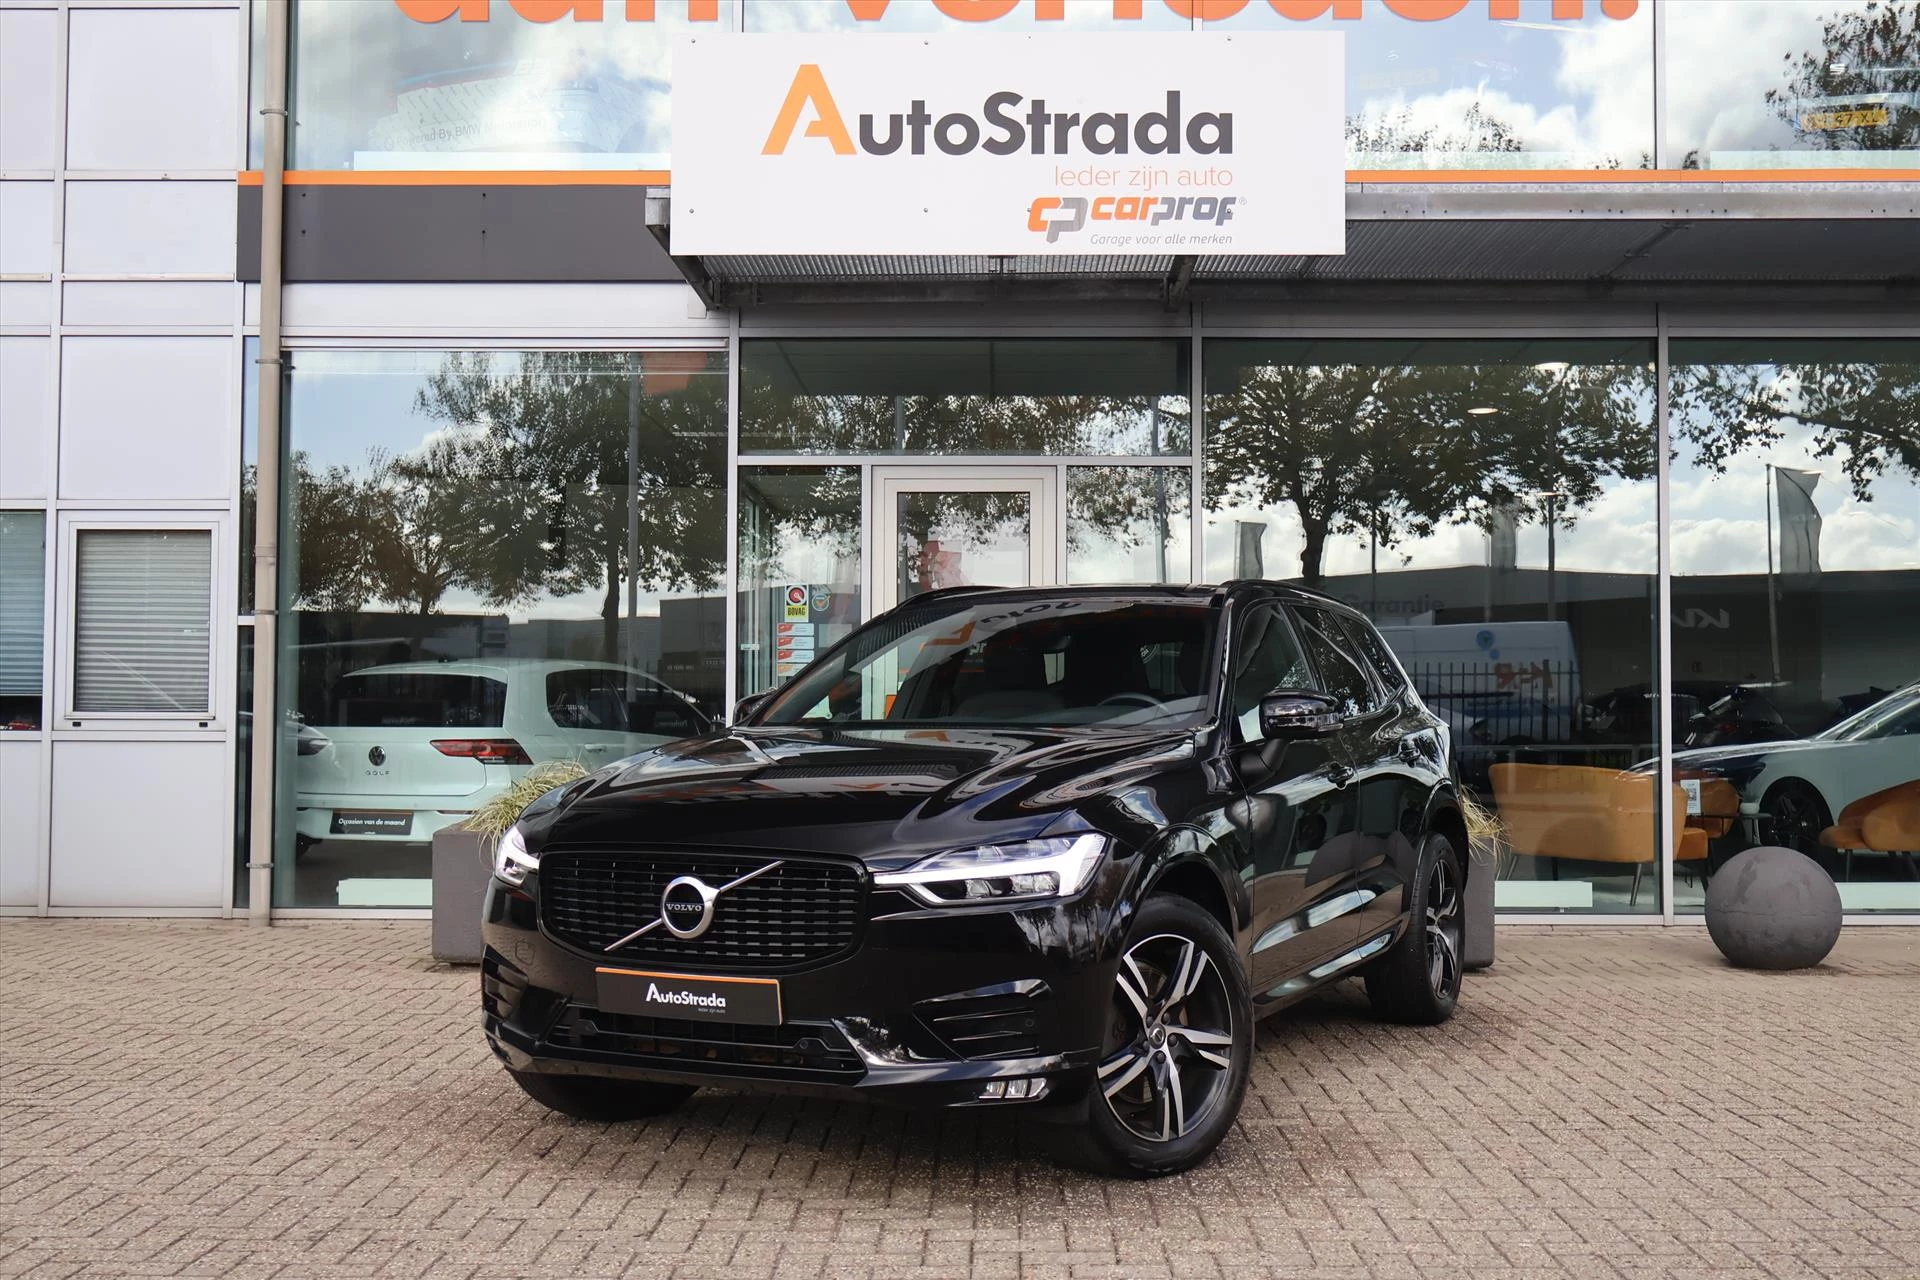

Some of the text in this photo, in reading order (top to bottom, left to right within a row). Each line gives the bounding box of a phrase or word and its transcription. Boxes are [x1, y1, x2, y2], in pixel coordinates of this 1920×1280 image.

[761, 64, 1233, 156] AutoStrada
[1055, 165, 1233, 191] Ieder zijn auto
[1090, 234, 1233, 247] Garage voor alle merken
[787, 606, 806, 616] BOVAG
[375, 818, 384, 826] de
[384, 818, 406, 826] maand
[666, 903, 702, 912] VOLVO
[646, 983, 726, 1007] AutoStrada
